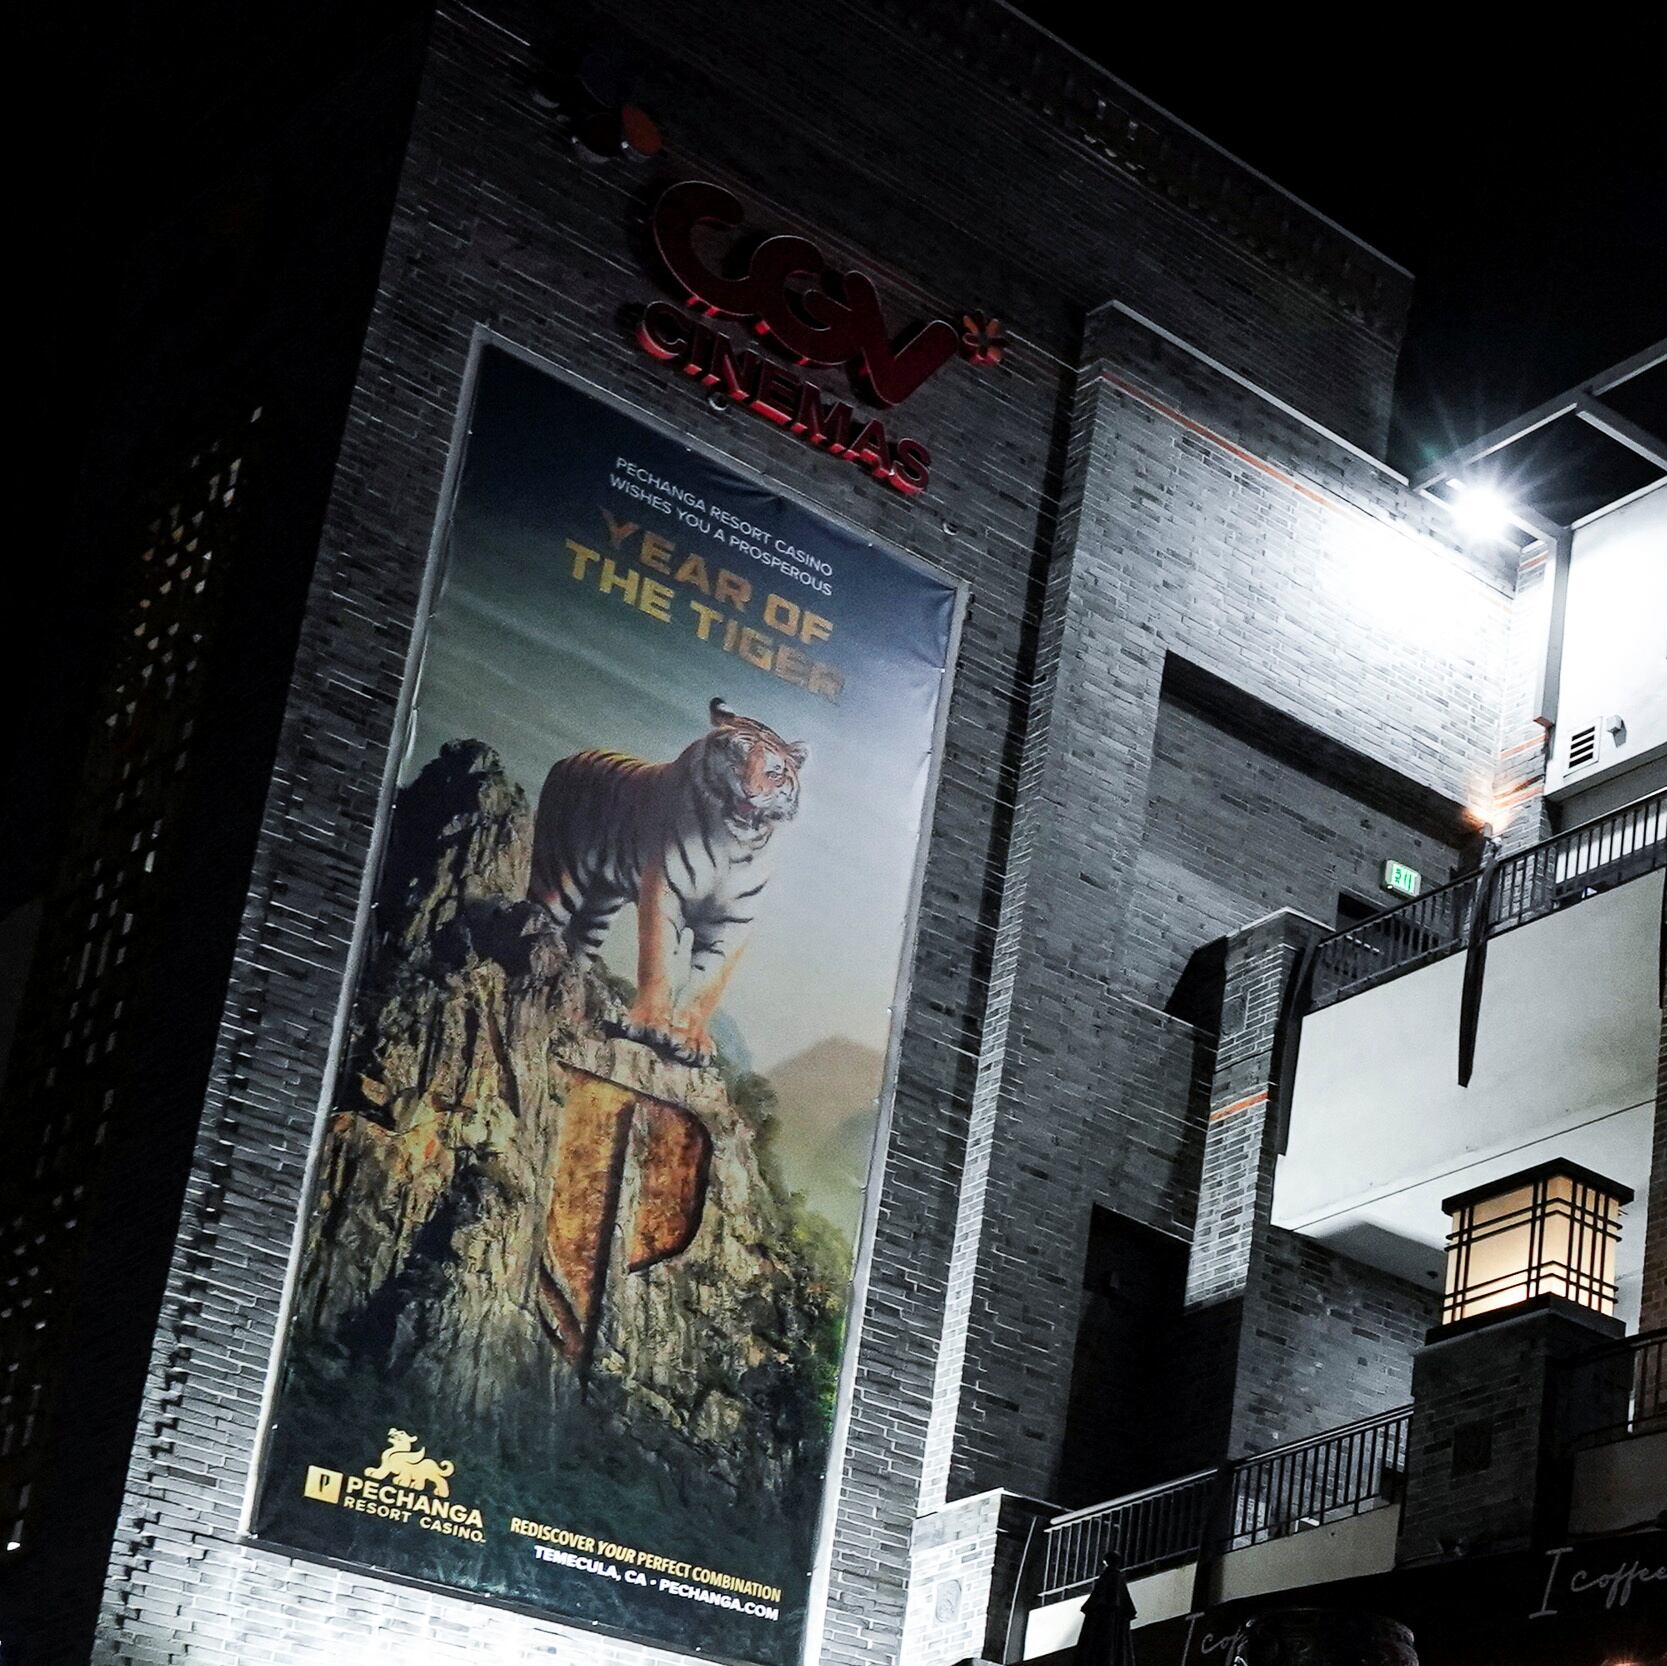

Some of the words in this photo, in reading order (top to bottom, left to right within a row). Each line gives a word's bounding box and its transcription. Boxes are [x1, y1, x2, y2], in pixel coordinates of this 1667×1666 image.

[652, 180, 959, 406] CGV
[635, 300, 931, 495] CINEMAS
[599, 503, 754, 614] YEAR
[762, 592, 834, 645] OF
[609, 472, 672, 515] WISHES
[676, 506, 711, 534] YOU
[713, 528, 726, 543] A
[728, 536, 833, 597] PROSPEROUS
[615, 456, 707, 513] PECHANGA
[709, 505, 773, 545] RESORT
[774, 539, 833, 577] CASINO
[564, 537, 676, 625] THE
[689, 600, 844, 704] TIGER
[343, 1496, 412, 1523] RESORT
[419, 1516, 485, 1543] CASINO
[346, 1476, 484, 1528] PECHANGA
[510, 1516, 594, 1553] REDISCOVER
[596, 1540, 636, 1564] YOUR
[636, 1551, 692, 1579] PERFECT
[691, 1566, 781, 1603] COMBINATION
[534, 1545, 622, 1582] TEMECULA,
[624, 1570, 647, 1587] CA
[659, 1578, 779, 1621] PECHANGA.COM
[1528, 1546, 1574, 1620] I
